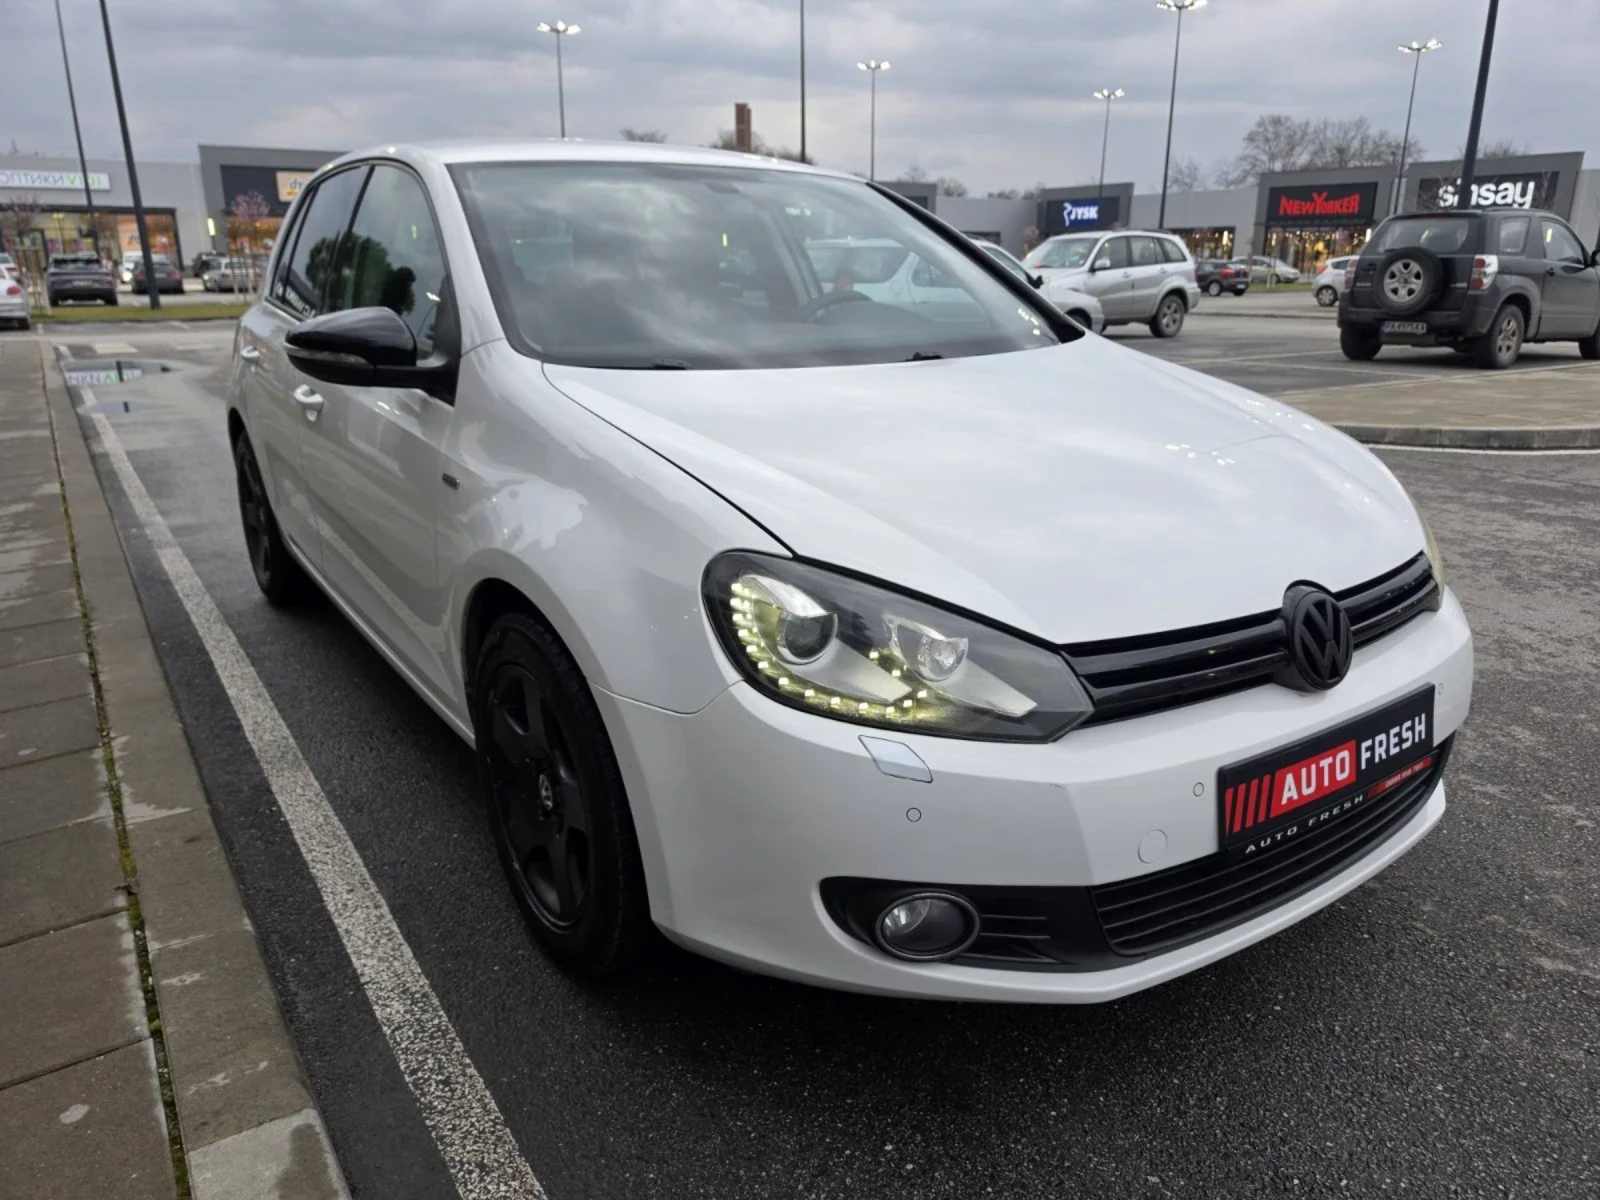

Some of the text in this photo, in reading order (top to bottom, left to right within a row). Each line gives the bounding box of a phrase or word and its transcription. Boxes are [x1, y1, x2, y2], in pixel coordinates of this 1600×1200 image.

[1070, 205, 1098, 220] JYSK
[1281, 749, 1350, 806] AUTO
[1360, 713, 1427, 770] FRESH
[1245, 794, 1364, 854] AUTO FRESH
